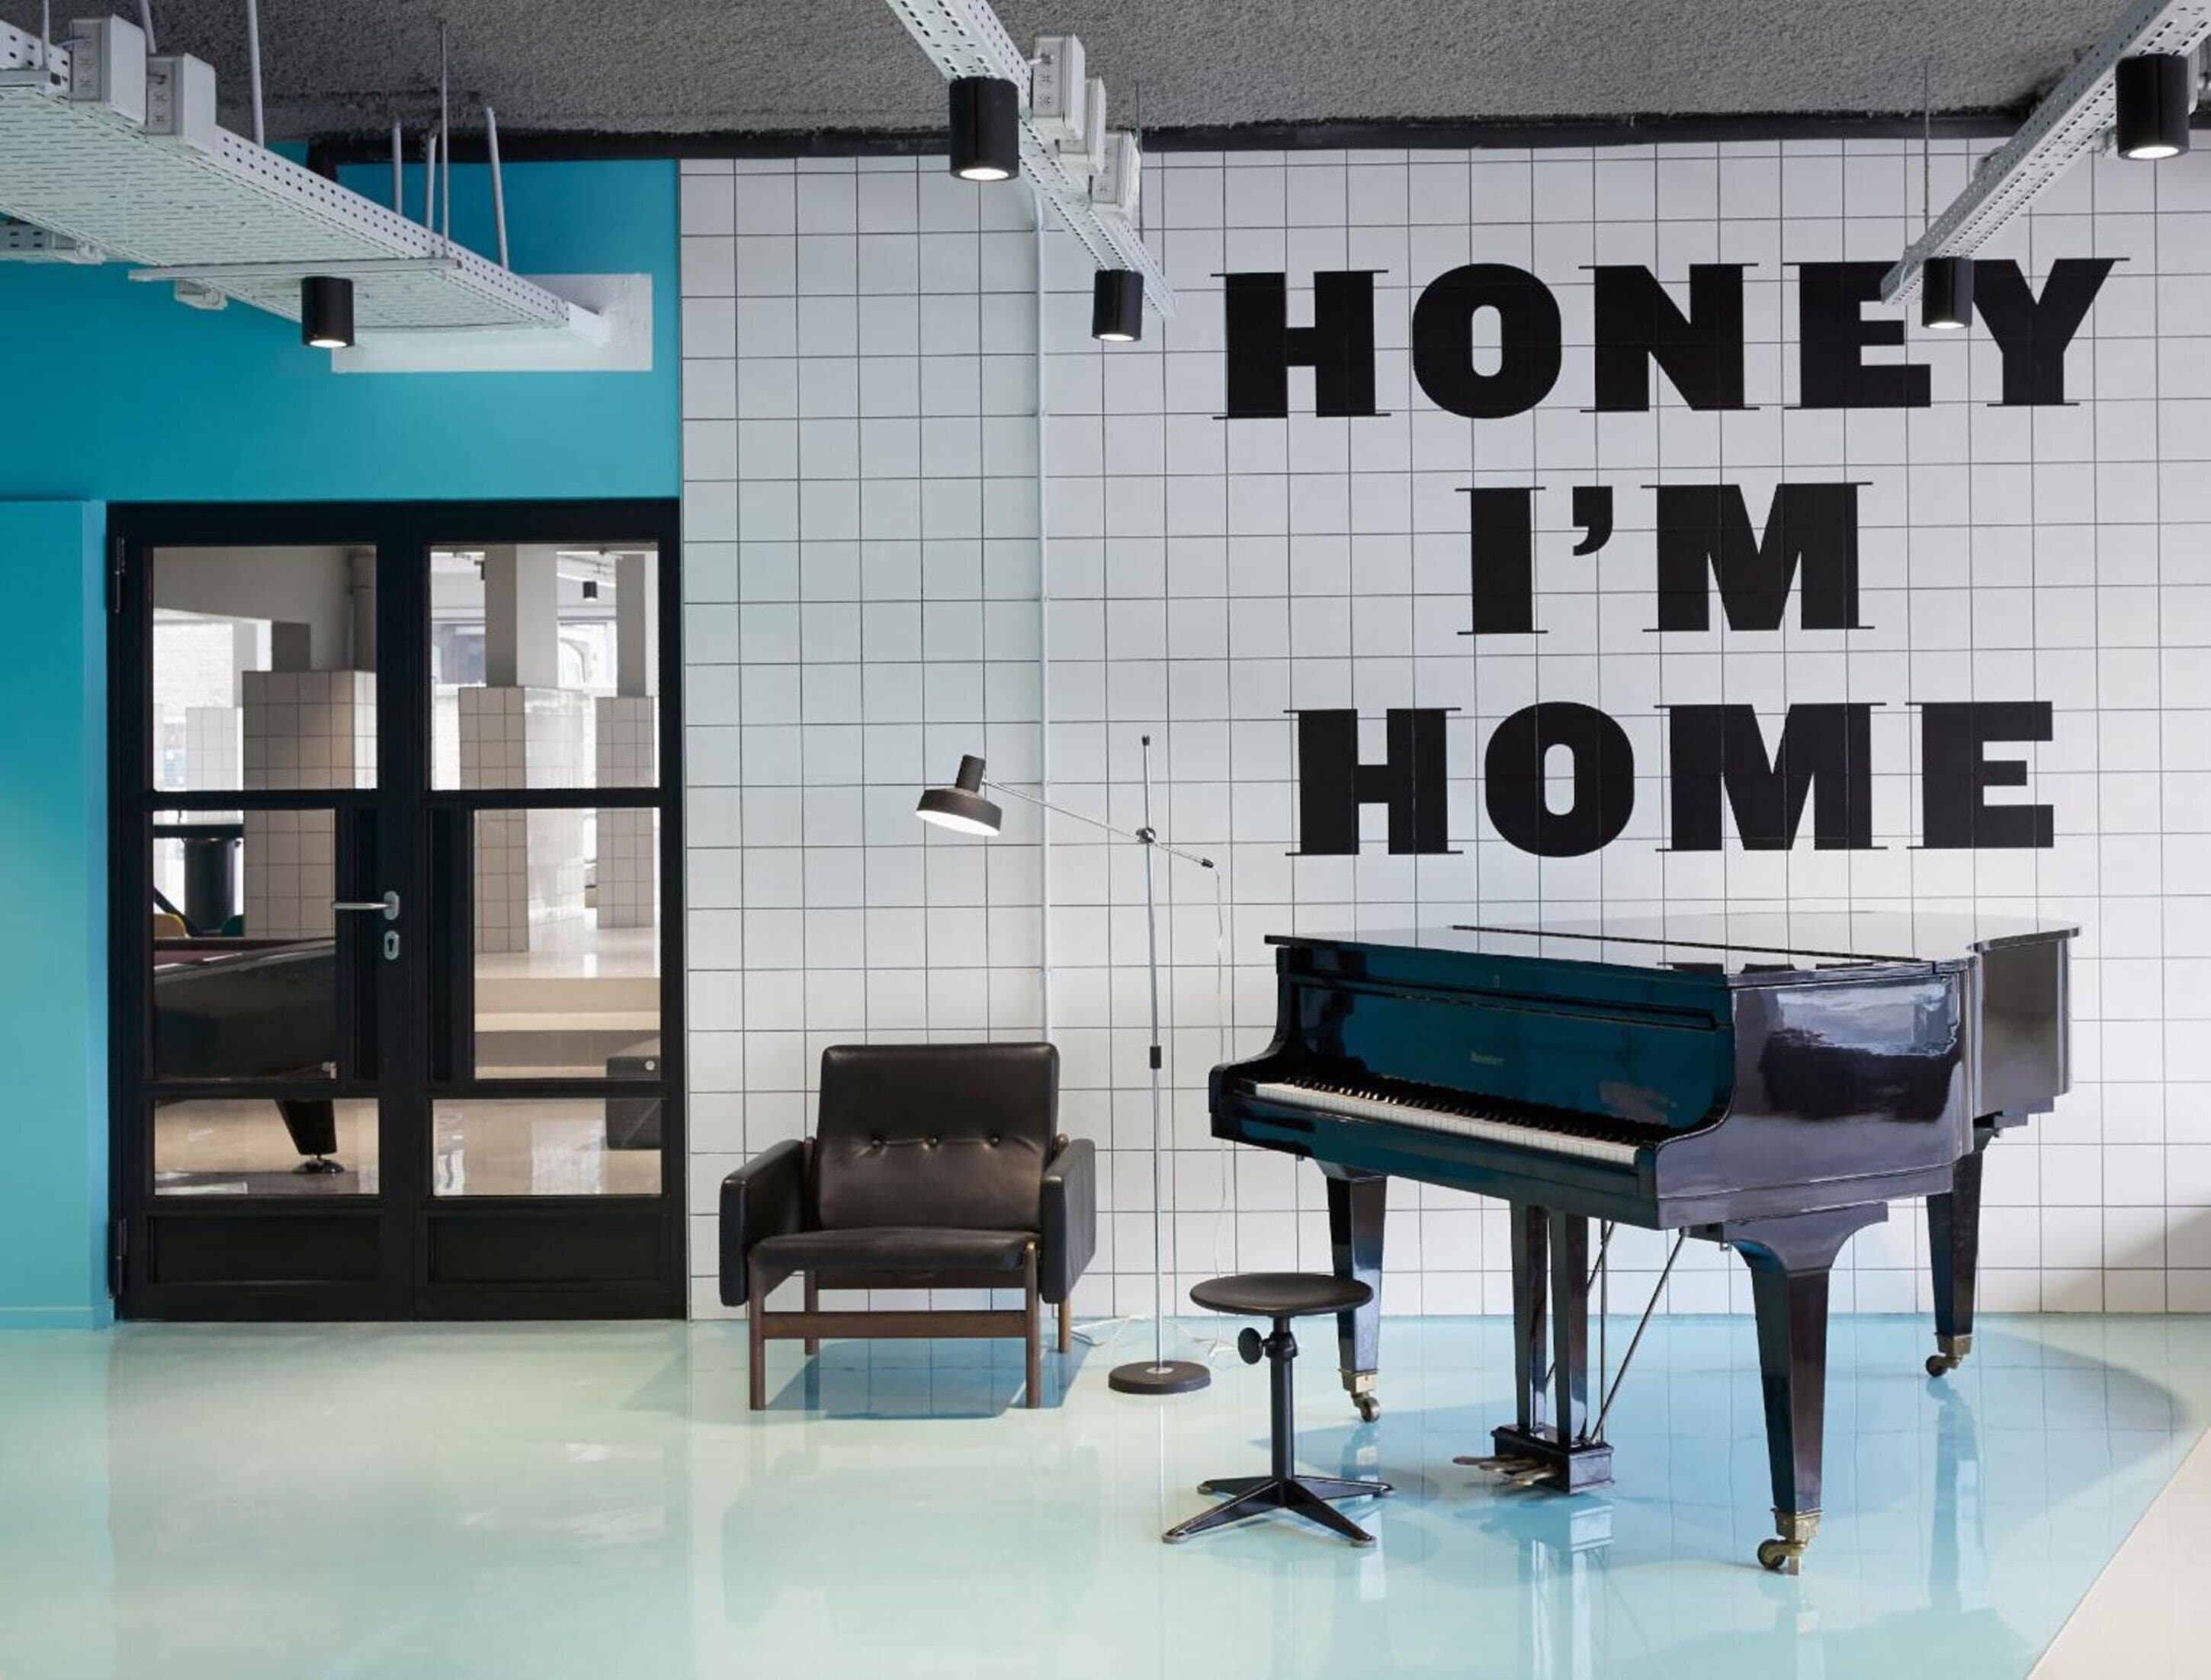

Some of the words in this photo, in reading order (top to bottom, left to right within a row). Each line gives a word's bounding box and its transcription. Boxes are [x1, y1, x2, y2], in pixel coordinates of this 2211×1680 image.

[1211, 258, 2130, 419] HONEY
[1455, 481, 1875, 635] I'M
[1282, 701, 2055, 858] HOME
